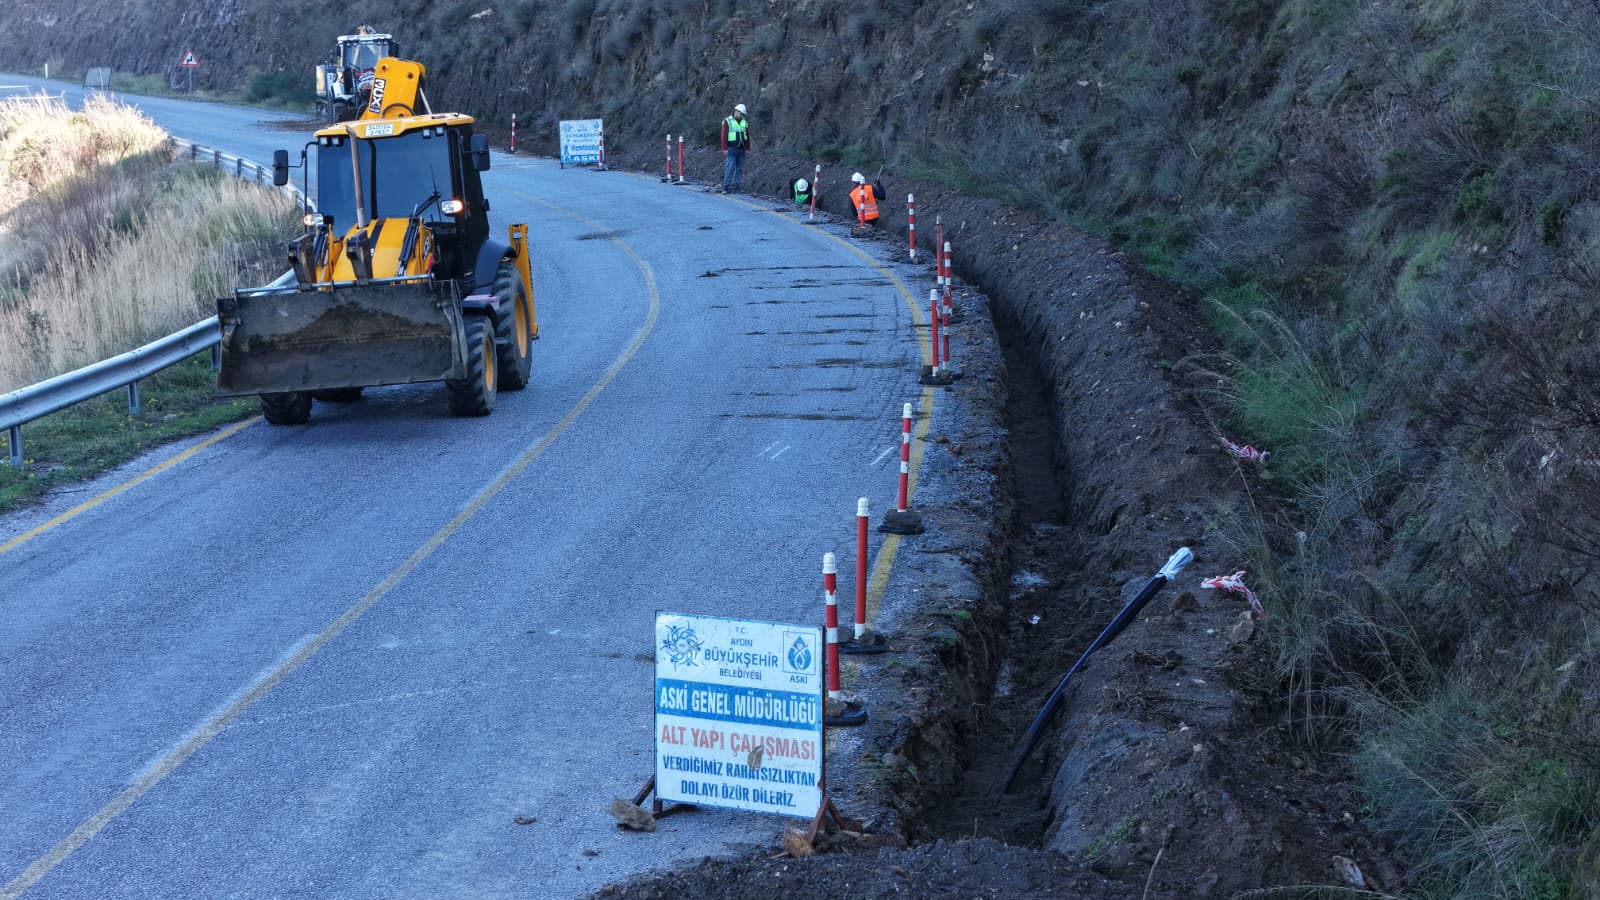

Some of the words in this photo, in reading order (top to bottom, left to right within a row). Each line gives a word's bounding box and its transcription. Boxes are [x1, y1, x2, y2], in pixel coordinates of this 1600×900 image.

[371, 79, 385, 107] 3CX
[731, 638, 753, 647] AYDIN
[704, 647, 778, 668] BÜYÜKŞEHİR
[720, 667, 762, 680] BELEDİYESİ
[790, 675, 808, 684] ASKİ
[660, 684, 688, 711] ASKİ
[691, 690, 731, 715] GENEL
[734, 691, 817, 725] MÜDÜRLÜĞÜ
[661, 725, 687, 744] ALT
[691, 728, 724, 750] YAPI
[730, 732, 815, 761] ÇALIŞMASI
[663, 755, 723, 776] VERDİĞİMİZ
[681, 780, 719, 798] DOLAYI
[722, 782, 749, 804] ÖZÜR
[753, 786, 797, 808] DİLERİZ.
